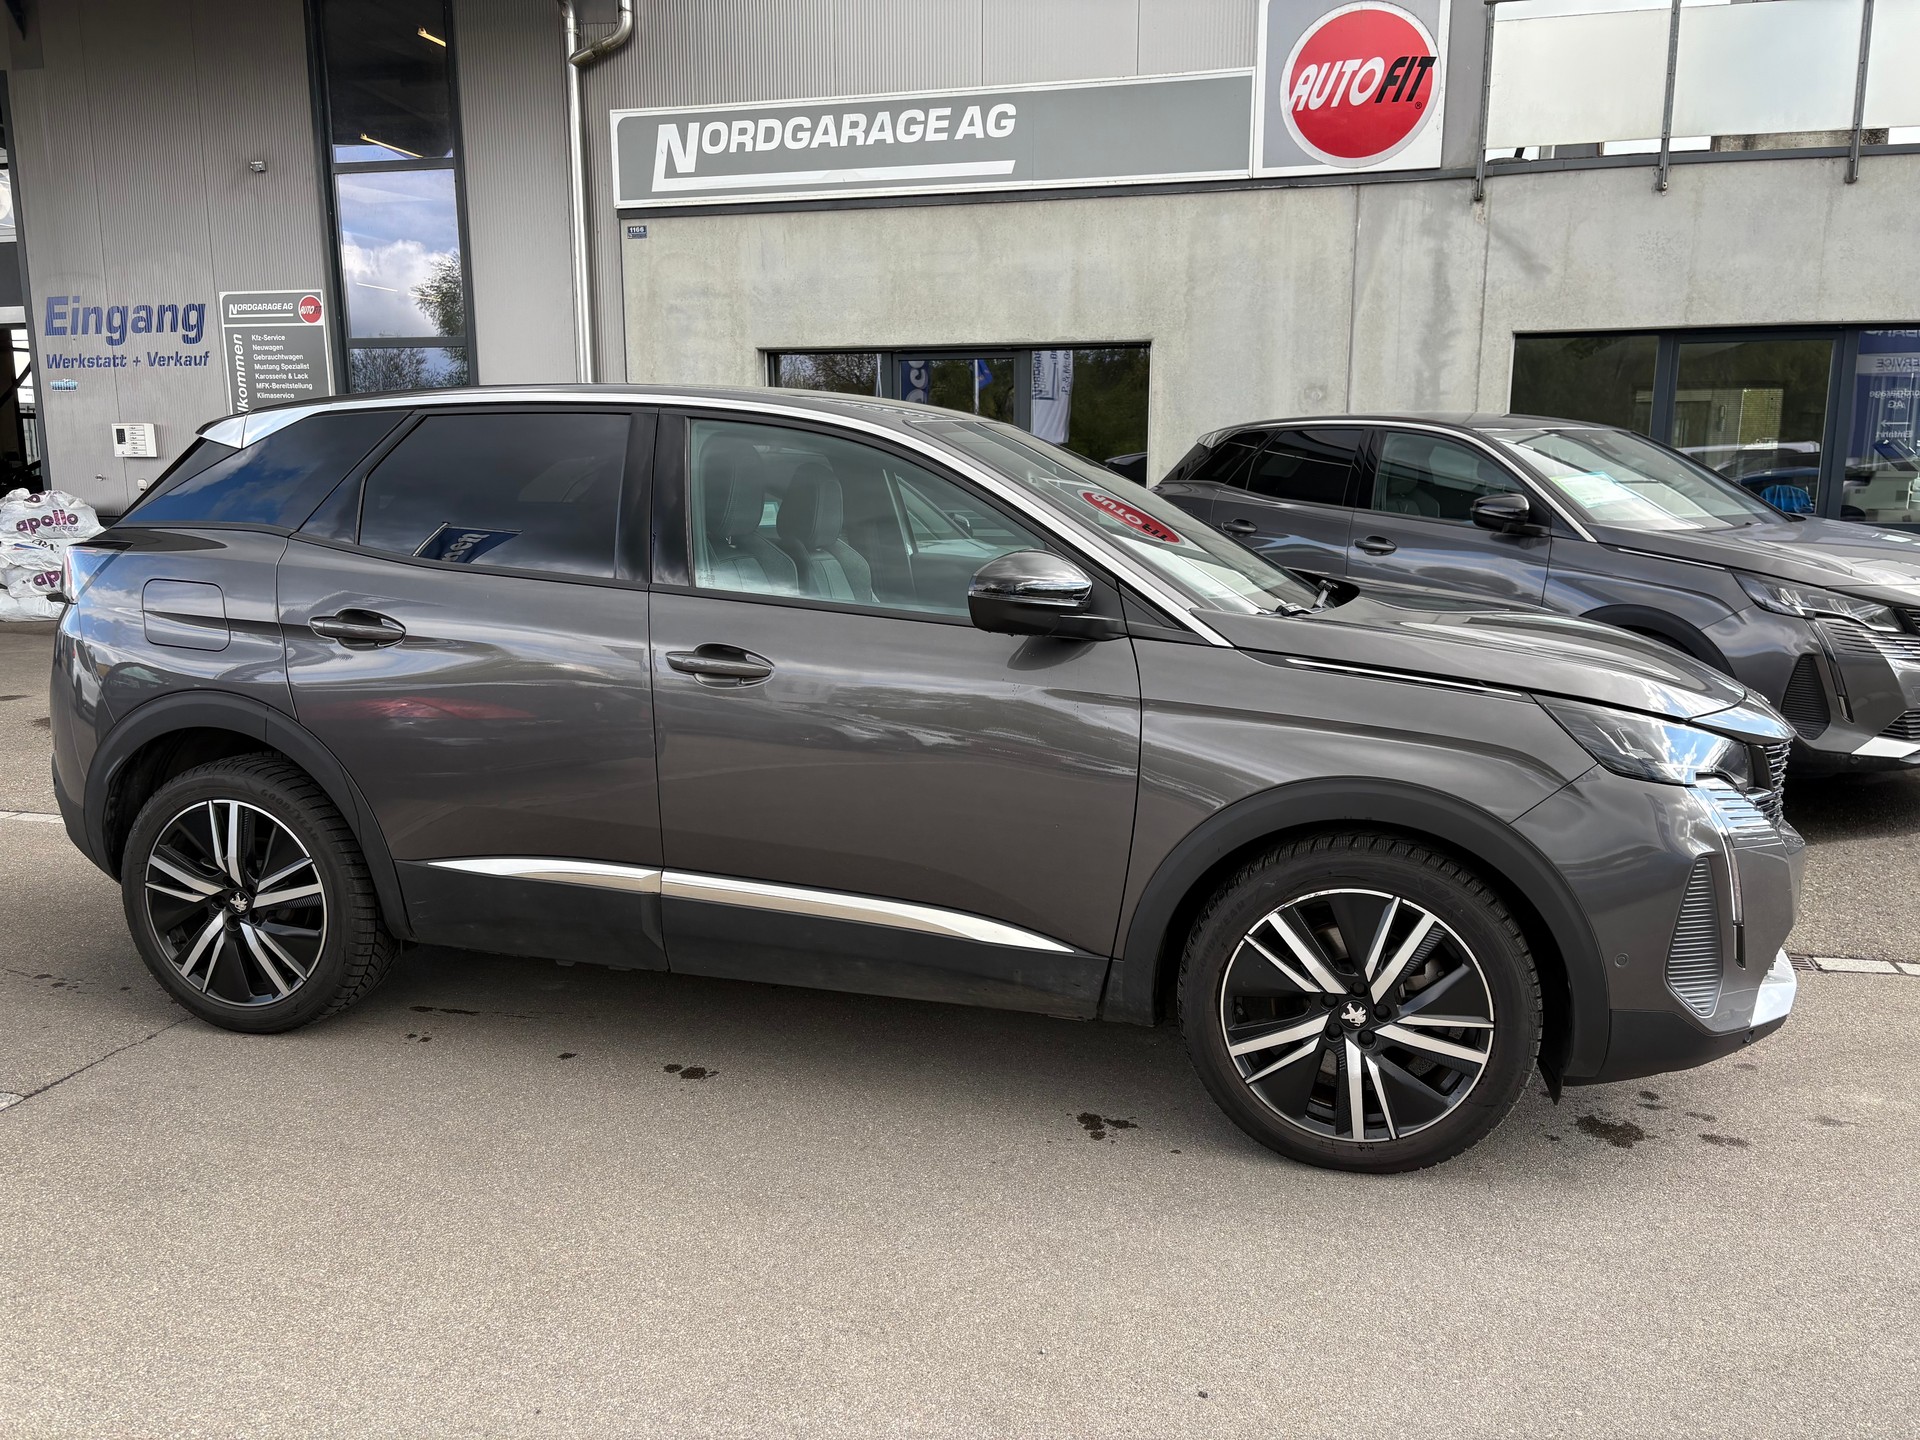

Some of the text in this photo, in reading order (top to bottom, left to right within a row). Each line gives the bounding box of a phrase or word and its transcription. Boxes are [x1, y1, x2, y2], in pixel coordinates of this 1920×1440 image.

[651, 102, 1017, 180] NORDGARAGE AG
[228, 302, 294, 314] NORDGARAGE AG
[44, 295, 206, 346] Eingang
[252, 344, 284, 352] Neuwagen
[46, 350, 210, 369] Werkstatt + Verkauf
[253, 353, 304, 361] Gebrauchtwagen
[254, 363, 310, 371] Mustang Spezialist
[255, 372, 287, 380] Karosserie
[293, 372, 309, 380] Lack
[256, 382, 313, 390] MFK-Bereitstellung
[256, 391, 295, 399] Klimaservice
[16, 509, 79, 535] apollo
